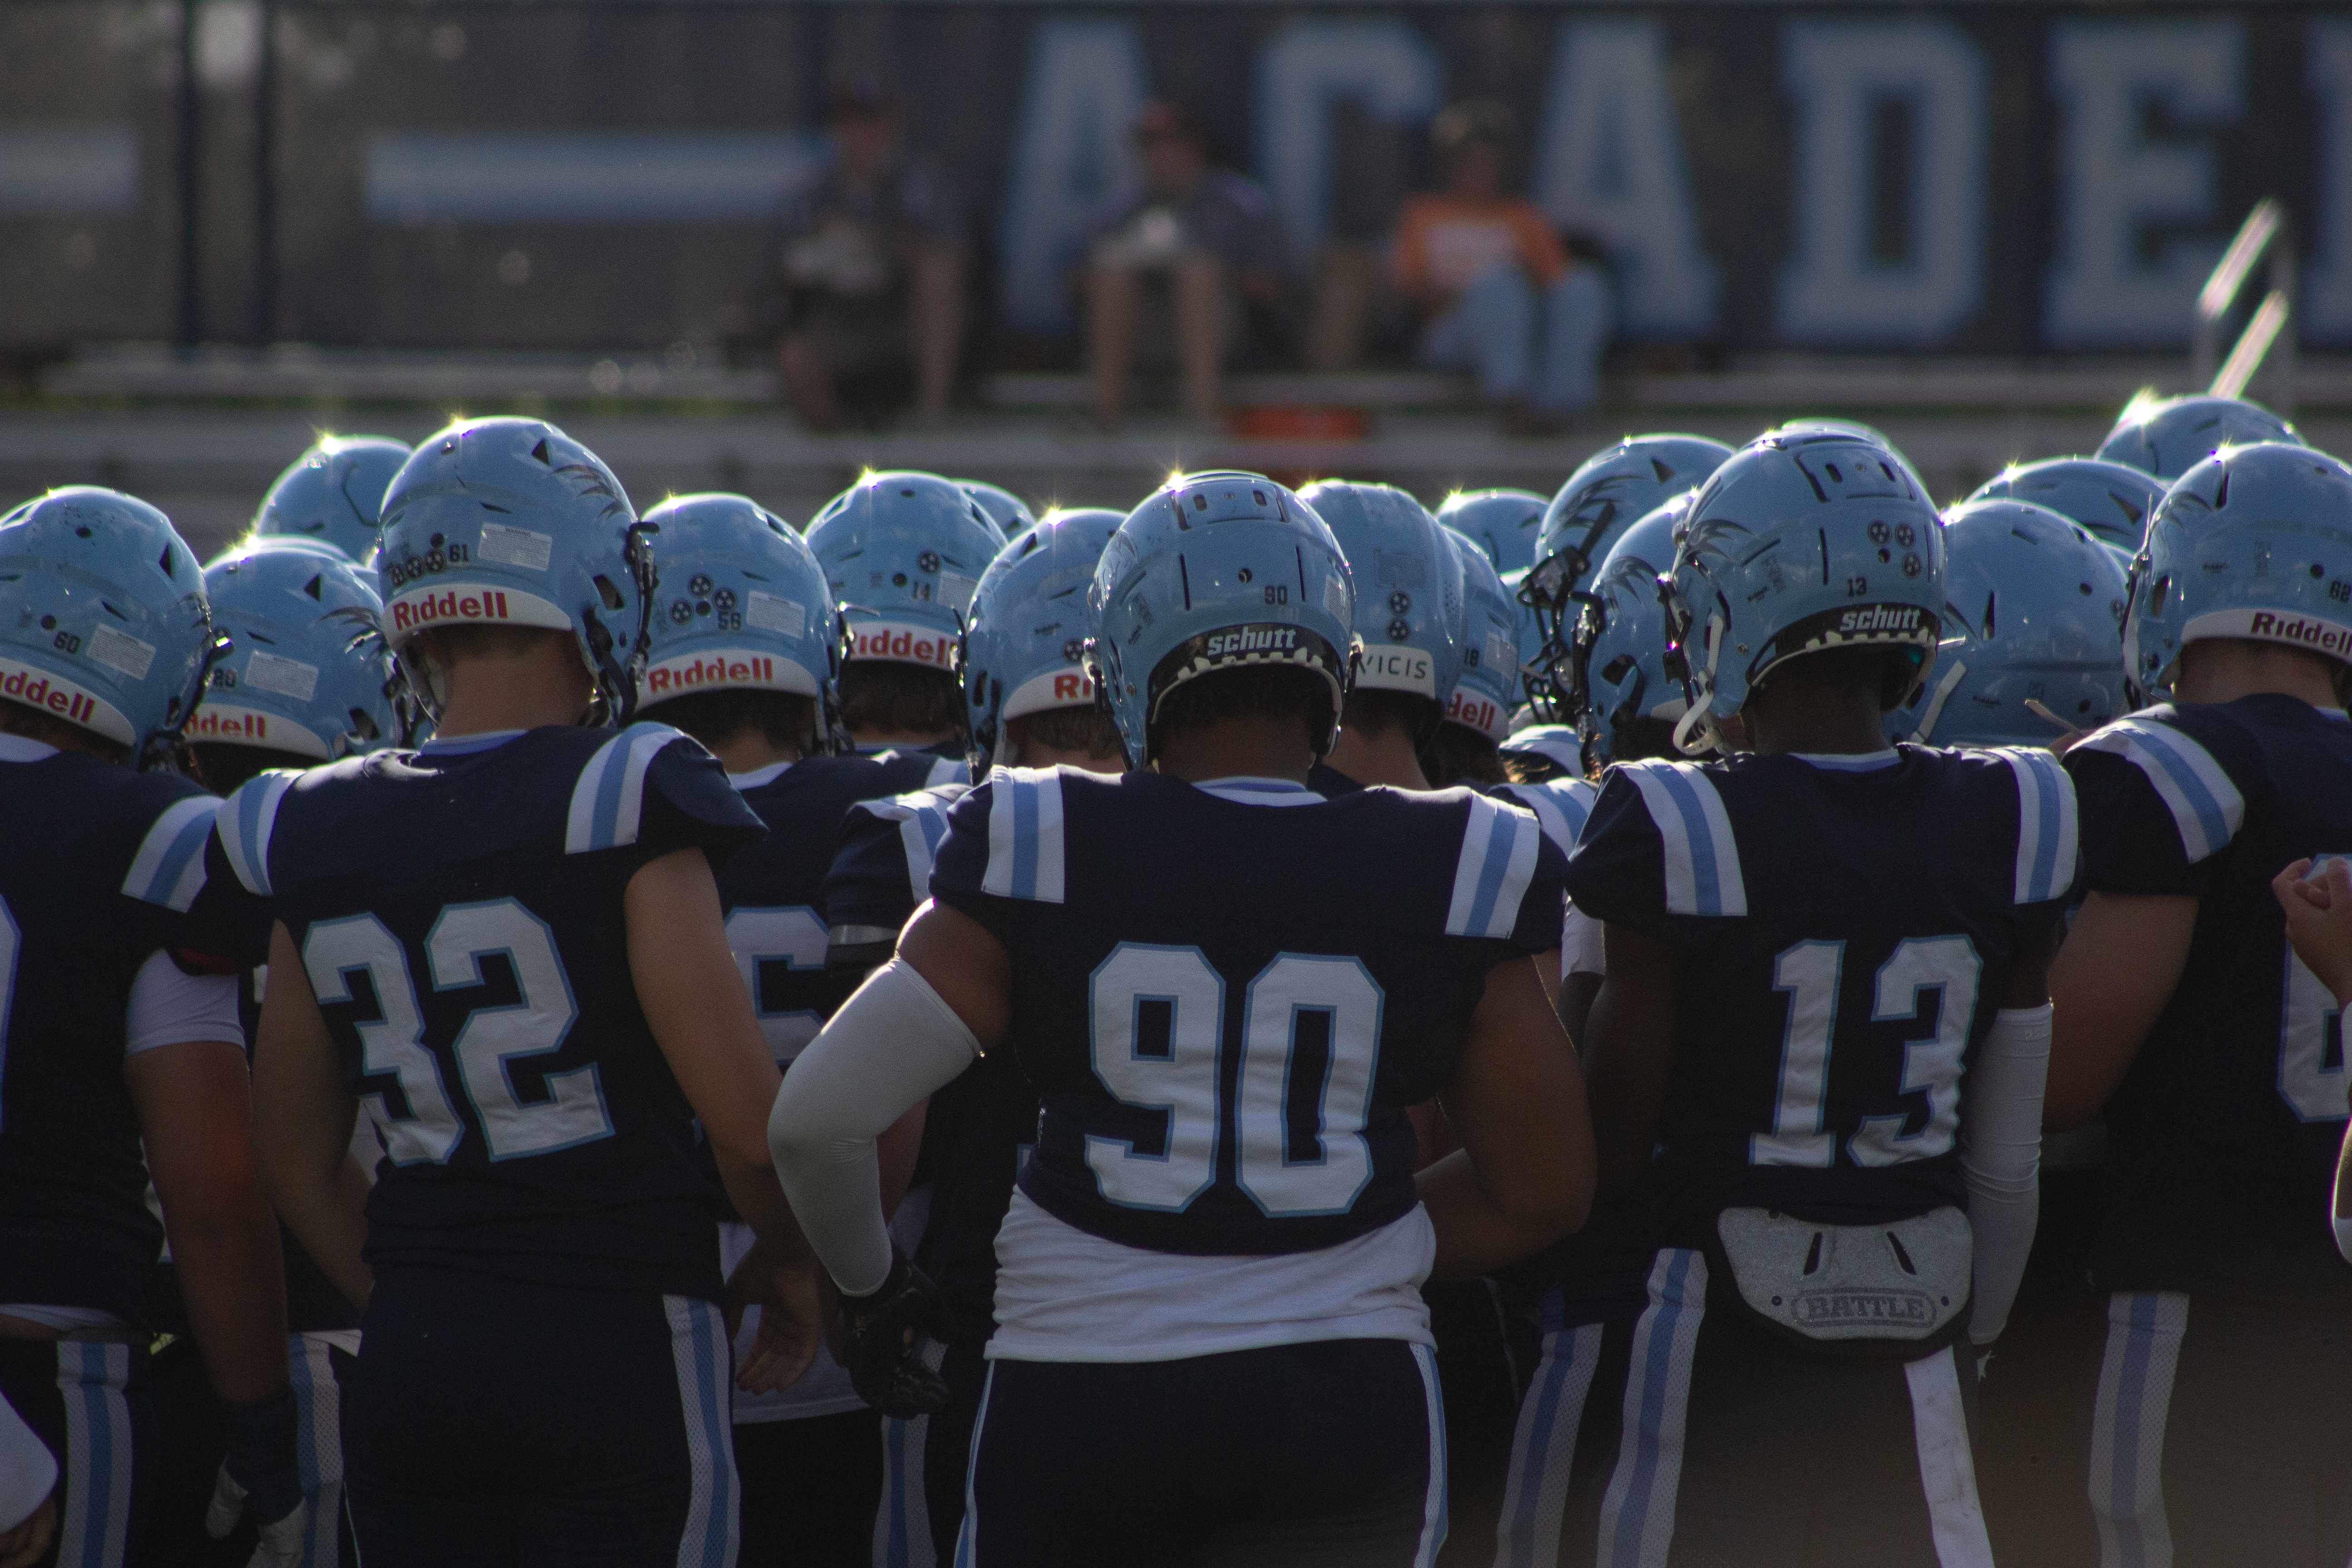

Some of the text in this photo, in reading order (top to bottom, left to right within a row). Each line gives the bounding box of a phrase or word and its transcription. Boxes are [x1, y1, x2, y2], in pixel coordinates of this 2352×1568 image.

[996, 16, 2352, 345] ACADE
[449, 544, 469, 563] 61
[1265, 585, 1288, 605] 90
[1847, 577, 1867, 597] 13
[393, 592, 508, 630] Riddell
[718, 612, 742, 630] 56
[1840, 604, 1921, 632] schutt
[53, 631, 81, 654] 60
[848, 629, 957, 664] iddel
[1207, 627, 1296, 657] schutt
[2251, 612, 2352, 655] Riddell
[1358, 656, 1427, 679] VICIS
[1464, 648, 1479, 667] 18
[649, 658, 772, 693] Riddell
[0, 671, 95, 722] ddell
[1446, 693, 1495, 730] dell
[303, 896, 616, 1167] 32
[1748, 933, 1984, 1167] 13
[1084, 941, 1385, 1218] 90
[1805, 1295, 1925, 1319] BATTLE
